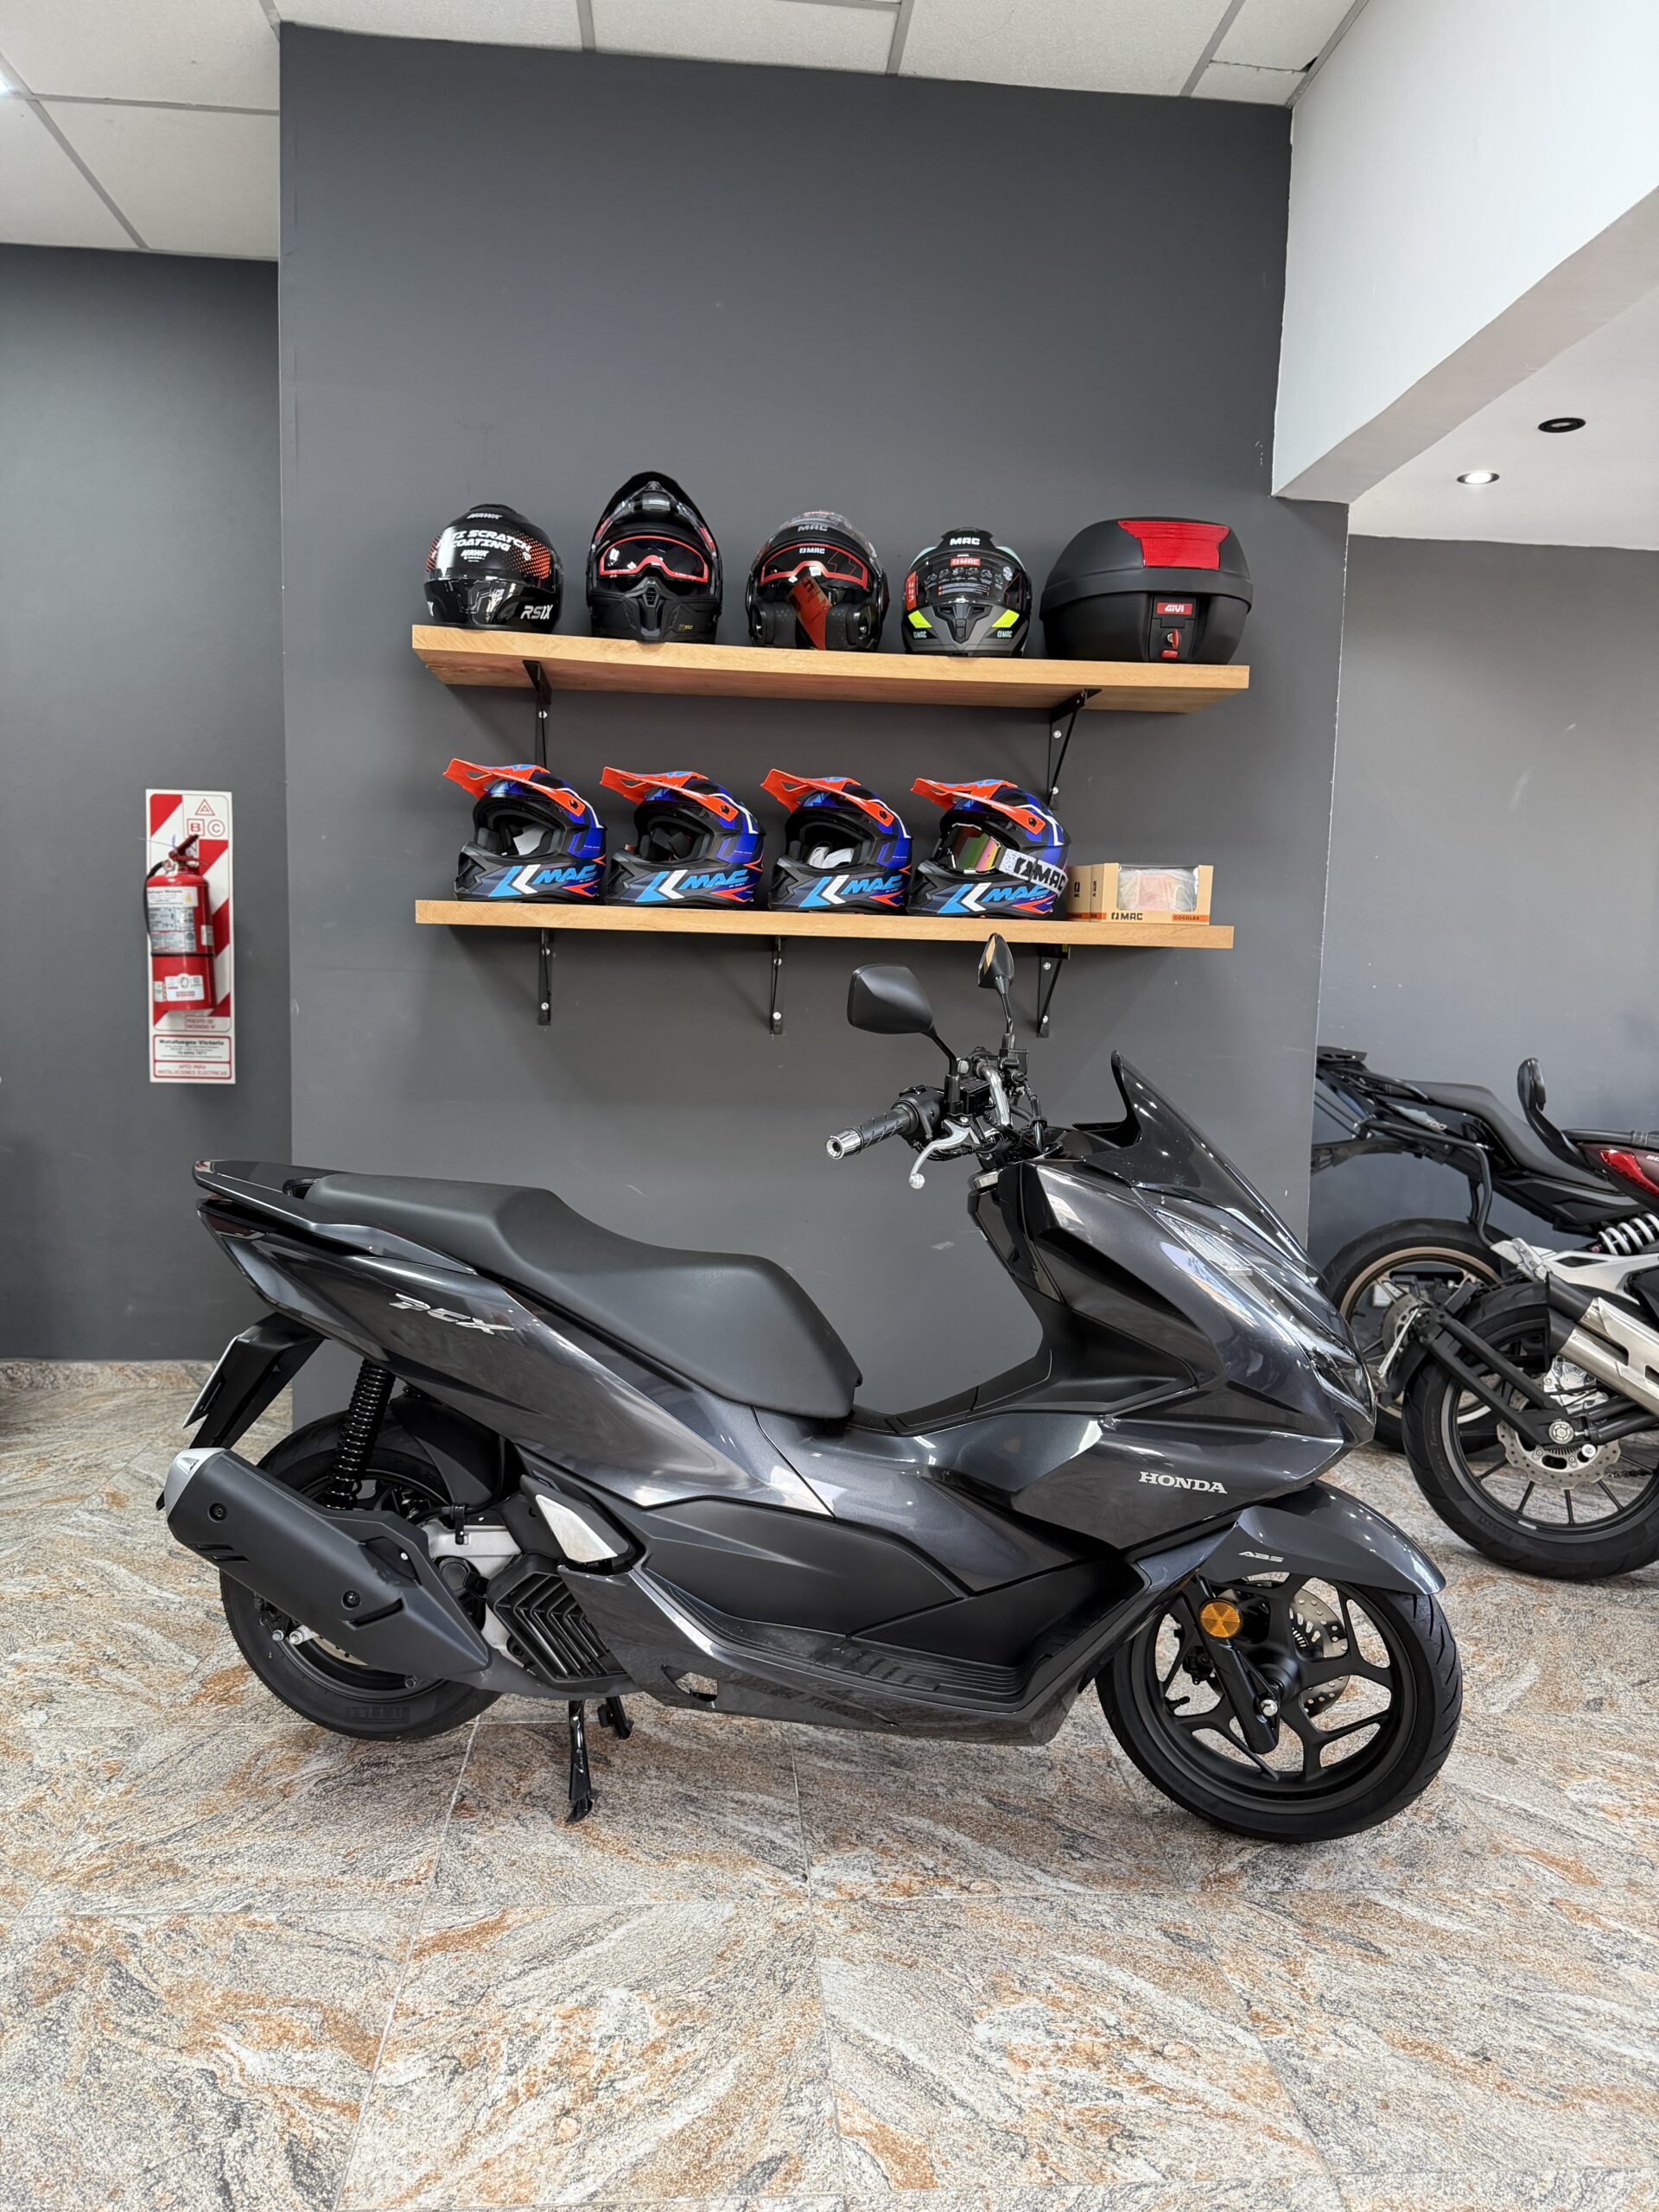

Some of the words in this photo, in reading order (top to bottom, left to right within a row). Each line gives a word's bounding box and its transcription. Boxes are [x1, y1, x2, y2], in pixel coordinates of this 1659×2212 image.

[451, 538, 512, 551] COATING
[467, 530, 532, 552] SCRATCH
[1165, 604, 1184, 613] GIVI
[190, 823, 200, 832] B
[212, 823, 220, 833] C
[532, 864, 597, 886] MAC
[678, 869, 749, 890] MAC
[841, 874, 903, 895] MAC
[1033, 864, 1065, 891] MAC
[390, 1294, 514, 1334] PCX
[1138, 1471, 1228, 1494] HONDA
[1238, 1551, 1285, 1563] ABS
